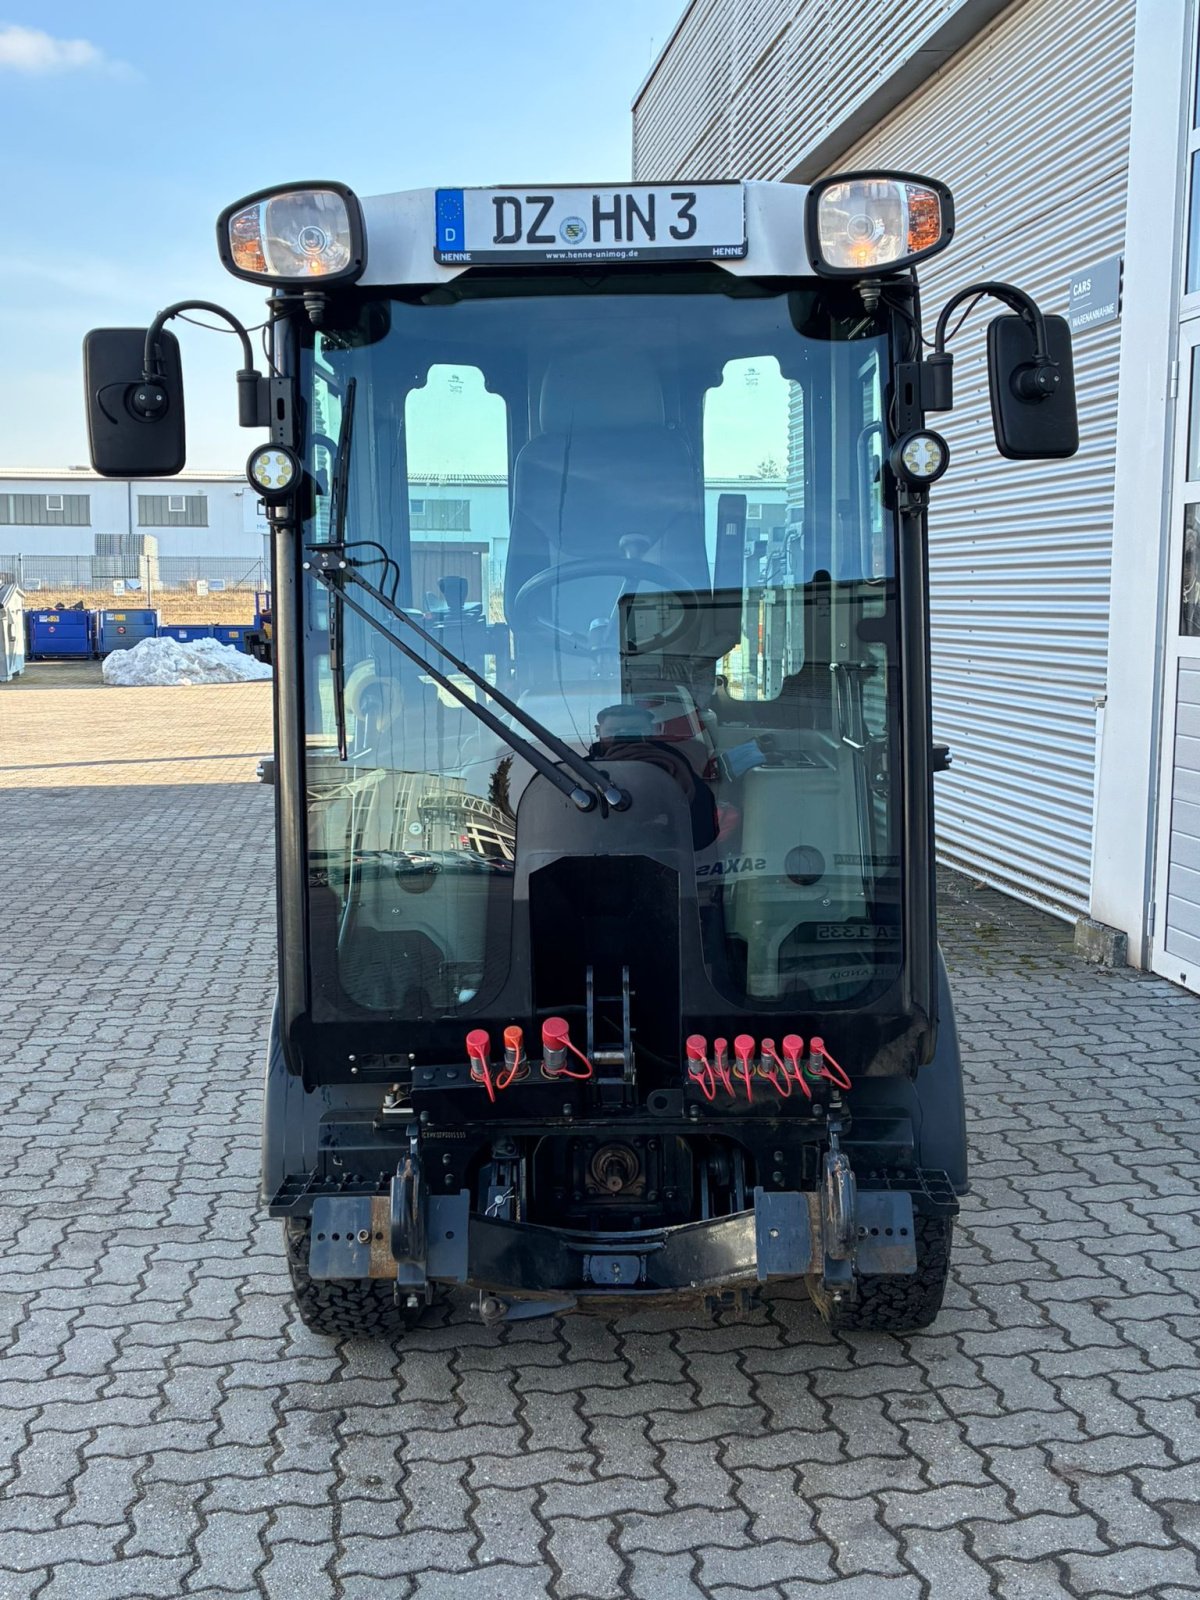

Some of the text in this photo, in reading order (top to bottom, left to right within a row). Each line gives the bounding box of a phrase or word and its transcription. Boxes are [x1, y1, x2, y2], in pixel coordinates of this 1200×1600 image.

[492, 196, 556, 244] DZ
[592, 193, 656, 243] HN
[669, 192, 697, 241] 3
[445, 228, 456, 242] D
[441, 252, 472, 262] HENNE
[545, 249, 639, 261] www.henne-unimog.de
[712, 246, 743, 256] HENNE
[1073, 278, 1092, 297] CARS
[1072, 302, 1115, 328] WARENANNAHME
